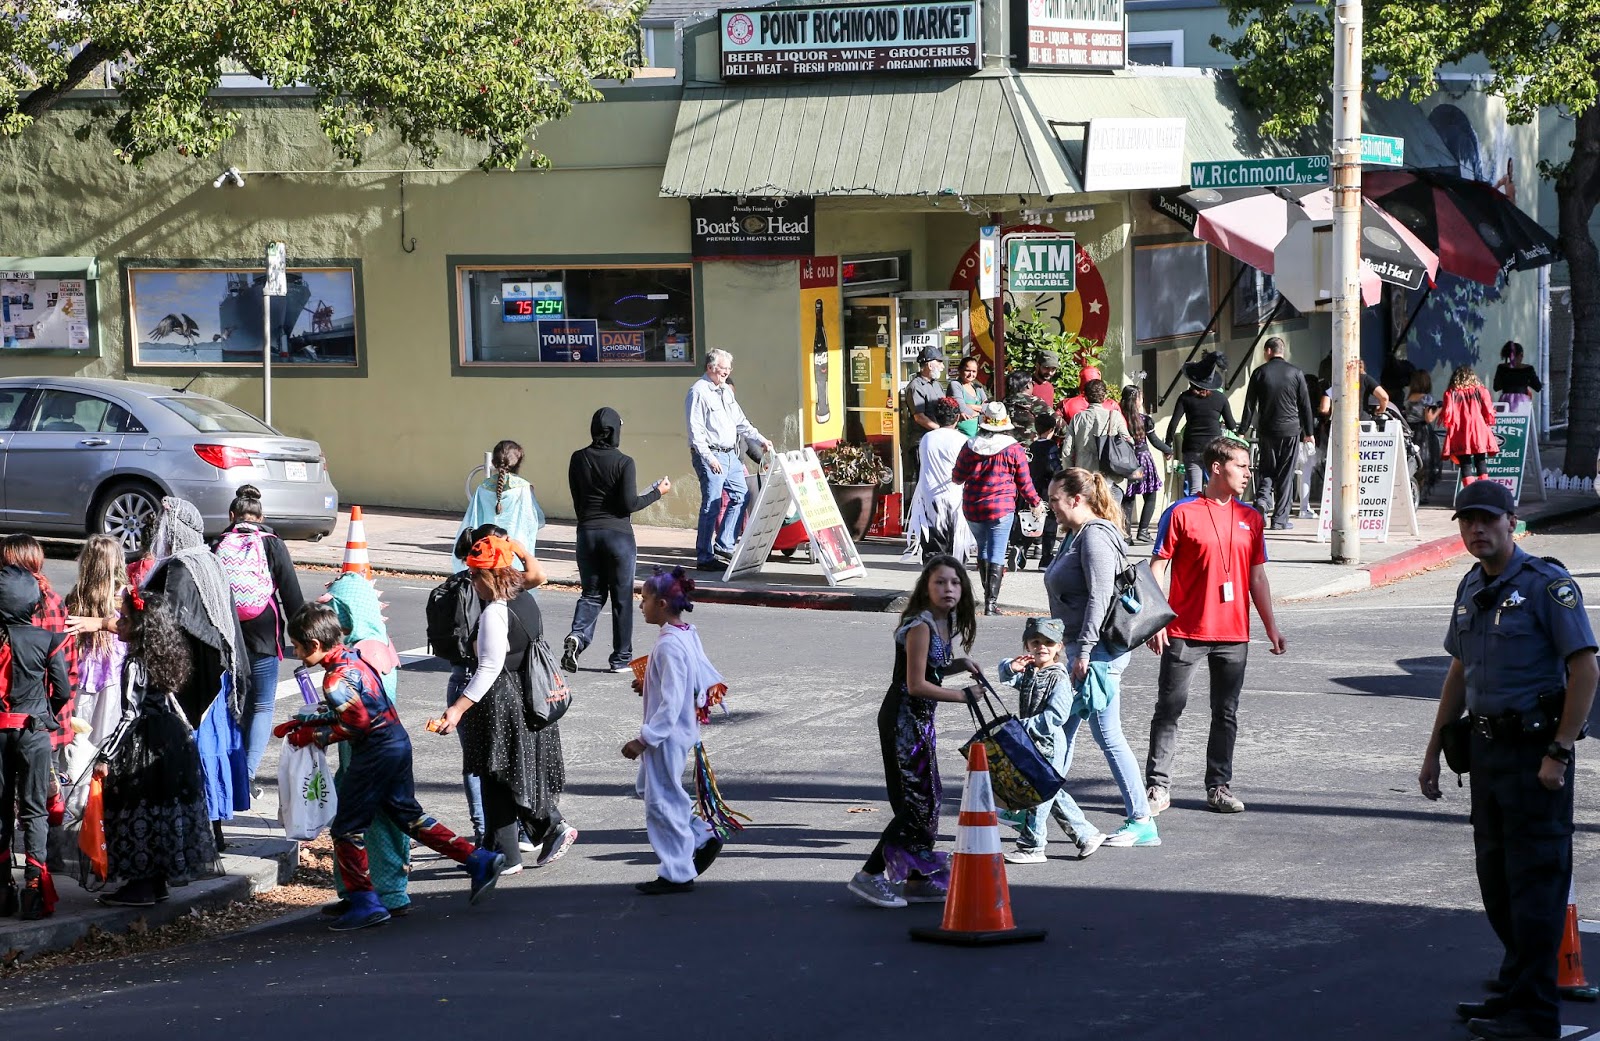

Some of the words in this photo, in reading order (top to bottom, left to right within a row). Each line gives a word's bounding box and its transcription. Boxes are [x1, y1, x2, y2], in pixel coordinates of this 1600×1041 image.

[760, 11, 809, 45] POINT
[813, 8, 899, 43] RICHMOND
[903, 5, 972, 41] MARKET
[728, 53, 763, 63] BEER
[776, 51, 828, 62] LIQUOR
[841, 49, 876, 60] WINE
[889, 46, 970, 58] GROCERIES
[726, 65, 747, 75] DELI
[757, 64, 782, 75] MEAT
[794, 62, 824, 73] FRESH
[828, 61, 874, 71] PRODUCE
[1307, 157, 1327, 168] 200
[1296, 173, 1312, 184] Ave
[1179, 206, 1194, 225] Head
[695, 216, 740, 235] Boar's
[767, 215, 810, 234] Head
[1013, 245, 1070, 272] ATM
[803, 267, 813, 279] ICE
[817, 266, 835, 278] COLD
[1386, 263, 1413, 281] Head
[516, 301, 532, 314] 75
[536, 300, 562, 314] 294
[542, 334, 566, 346] TOM
[567, 334, 594, 346] BUTT
[601, 333, 641, 346] DAVE
[910, 335, 930, 344] HELP
[905, 345, 925, 355] WAN
[1491, 426, 1523, 437] RKET
[1358, 451, 1385, 460] RKET
[1358, 465, 1389, 473] CERIES
[1358, 509, 1384, 517] ETTES
[1360, 520, 1384, 530] ICES!
